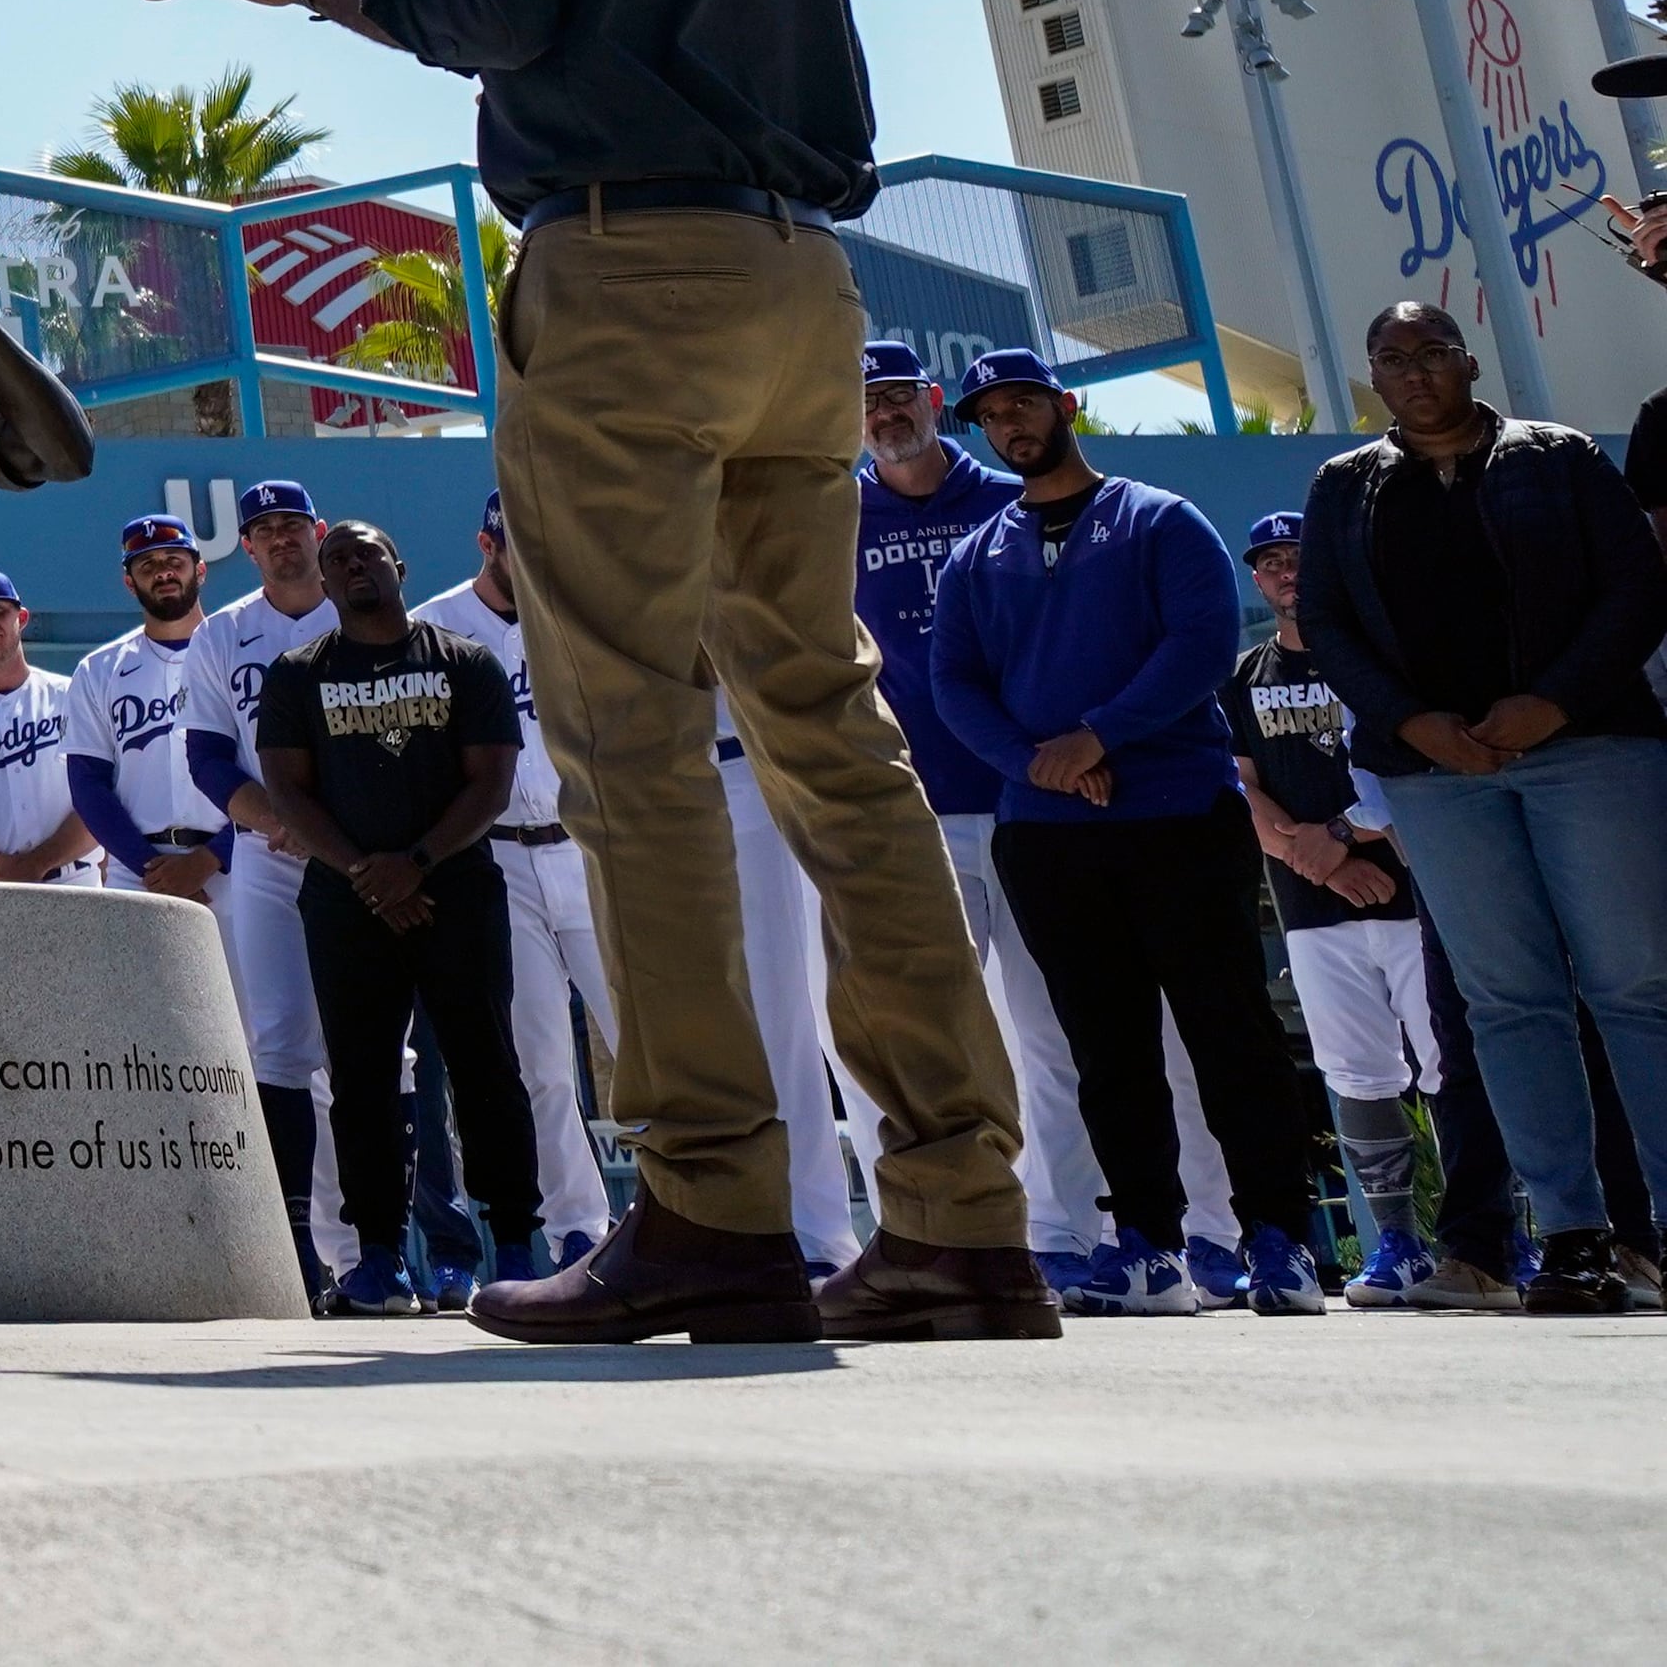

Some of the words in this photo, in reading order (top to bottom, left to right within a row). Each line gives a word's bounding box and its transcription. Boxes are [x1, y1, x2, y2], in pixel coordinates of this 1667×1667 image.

[975, 363, 998, 384] LA
[879, 530, 909, 544] LOS
[916, 523, 981, 538] ANGELE
[1091, 520, 1110, 543] LA
[1271, 518, 1292, 537] LA
[319, 670, 453, 710] BREAKING
[323, 698, 453, 737] BARRIERS
[384, 727, 404, 747] 42
[83, 1049, 114, 1091] in
[123, 1042, 174, 1093] this
[179, 1058, 248, 1111] country
[68, 1119, 105, 1170] of
[118, 1137, 152, 1170] us
[159, 1126, 182, 1170] is
